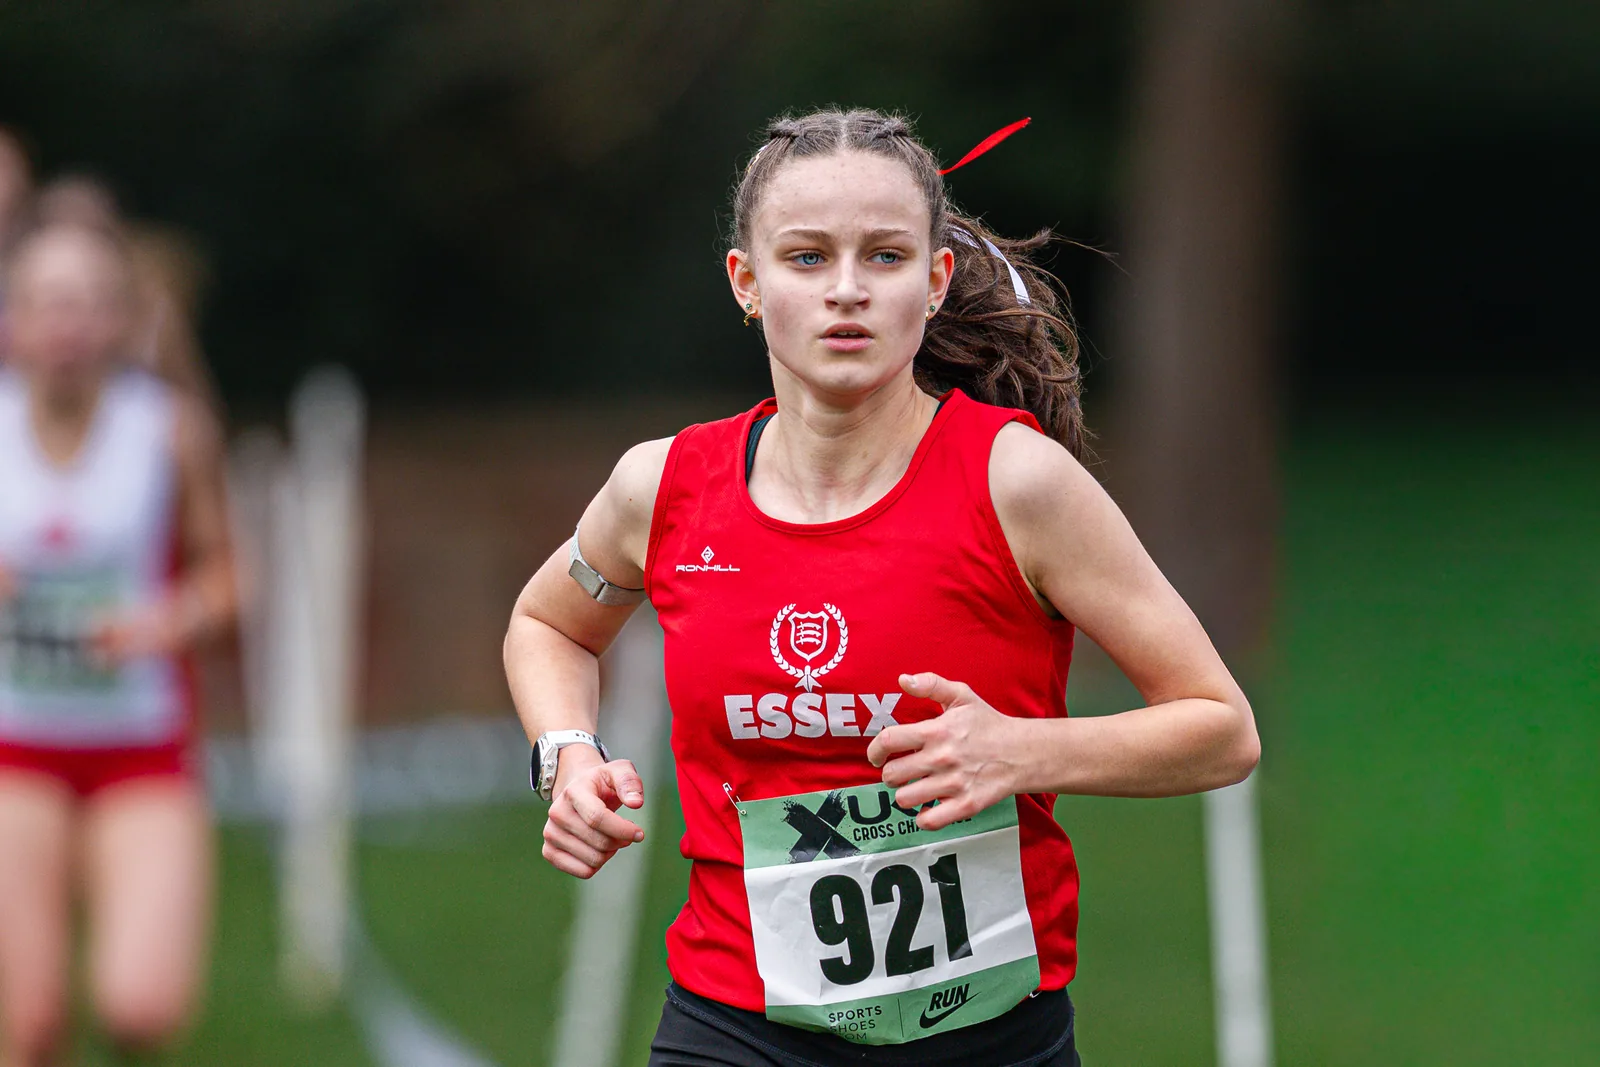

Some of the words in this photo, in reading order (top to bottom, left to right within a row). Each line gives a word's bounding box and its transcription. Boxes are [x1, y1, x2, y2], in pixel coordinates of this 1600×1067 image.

[675, 564, 741, 572] RONHILL
[723, 692, 903, 740] ESSEX
[853, 823, 895, 842] CROSS
[809, 853, 973, 986] 921
[928, 983, 971, 1012] RUN
[828, 1005, 882, 1023] SPORTS
